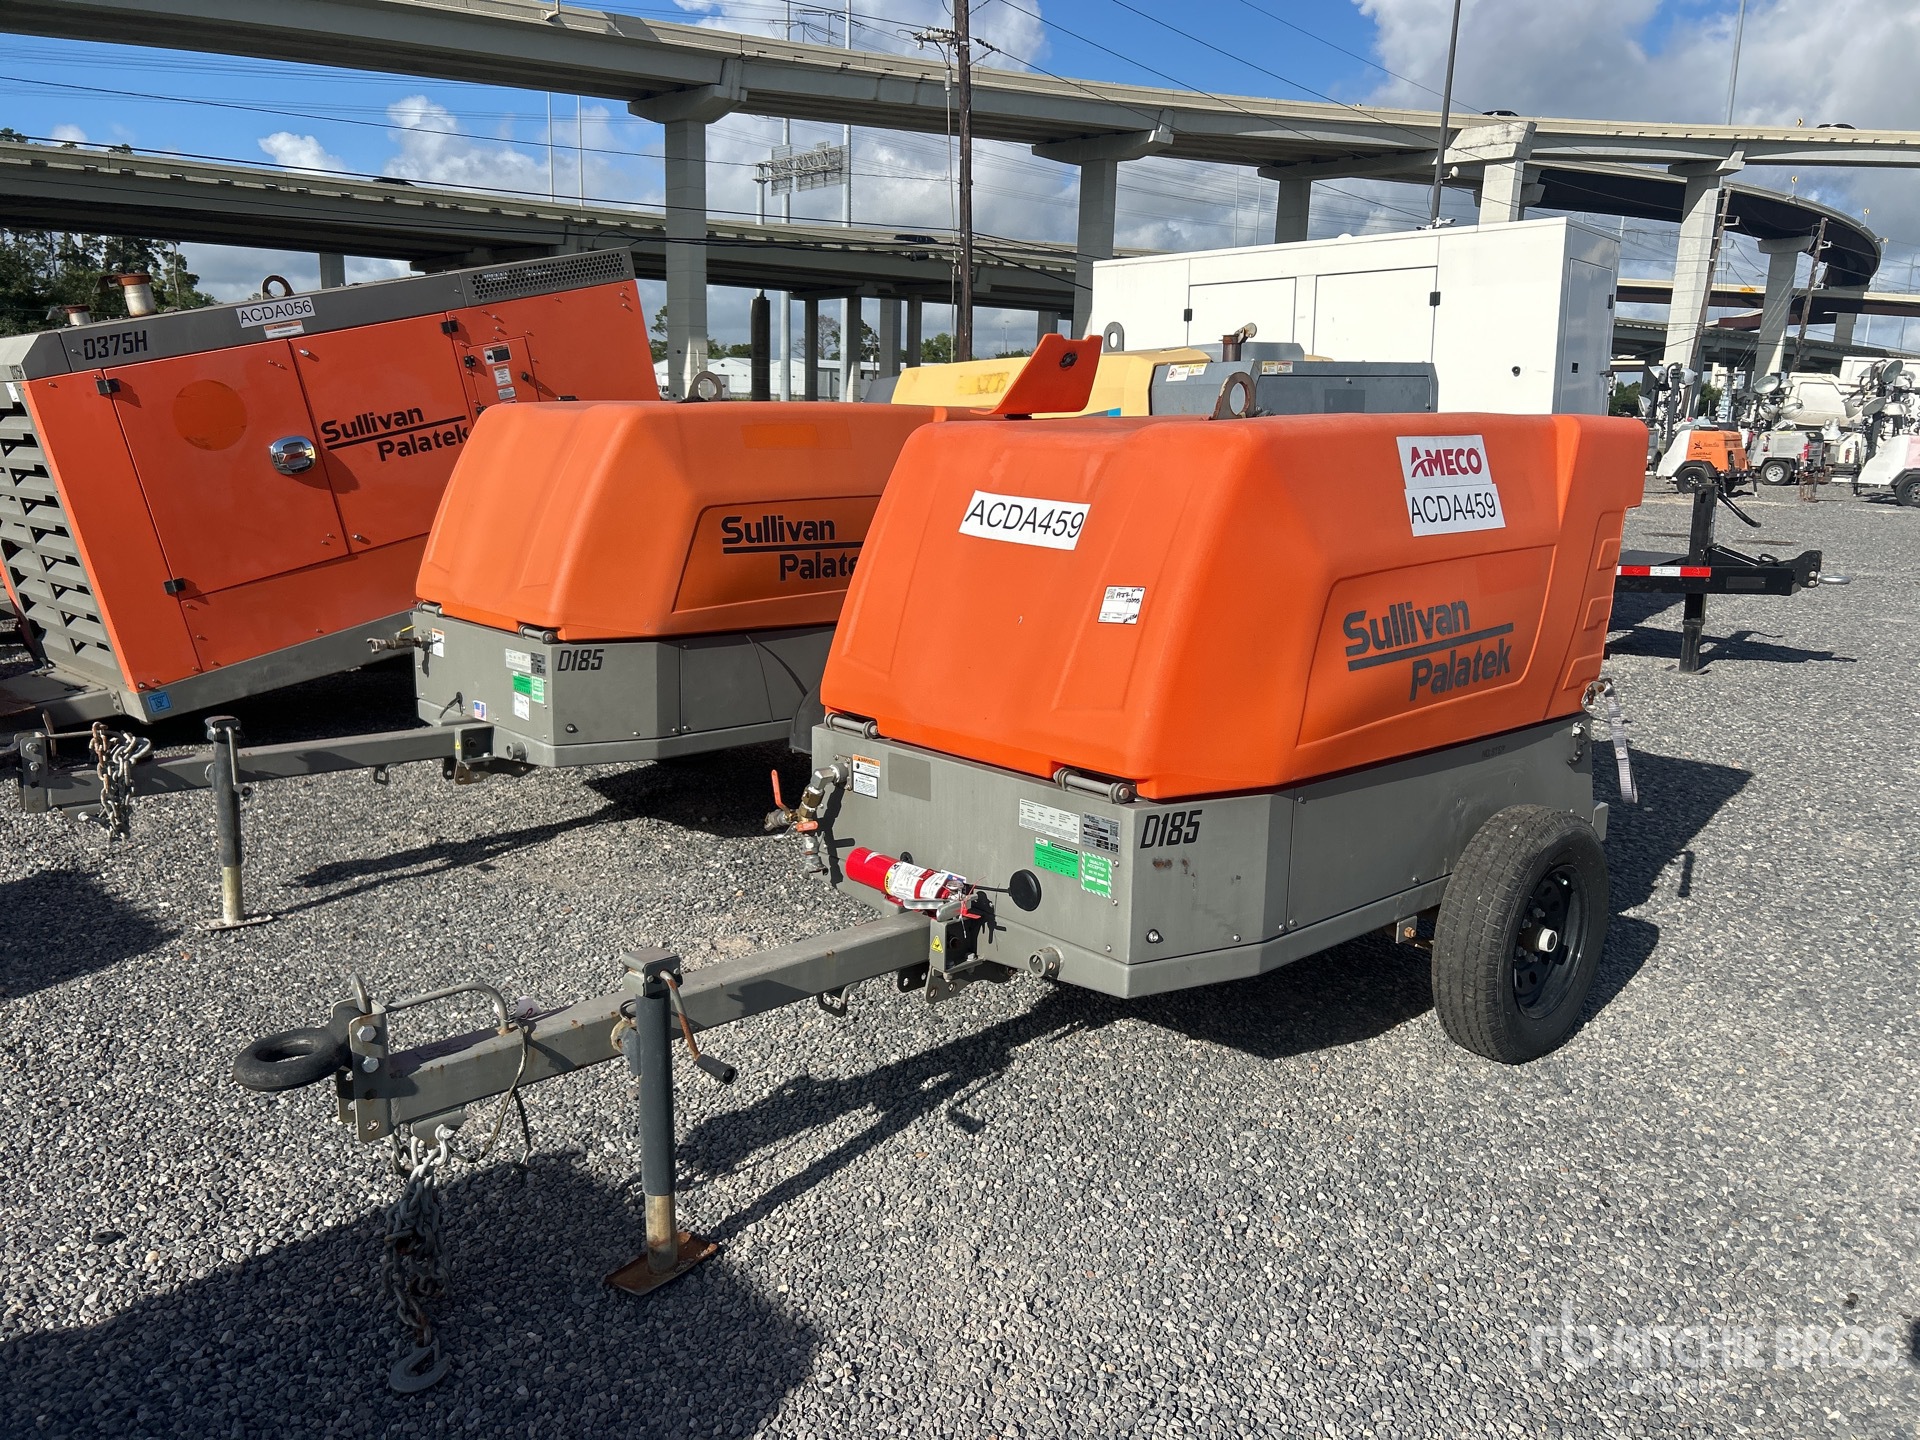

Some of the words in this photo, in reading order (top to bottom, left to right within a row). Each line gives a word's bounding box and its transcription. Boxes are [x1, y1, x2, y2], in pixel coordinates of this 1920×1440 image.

[240, 300, 312, 324] ACDA056
[83, 330, 148, 361] D375H
[320, 407, 425, 444] Sullivan
[376, 424, 470, 462] Palatek
[1411, 446, 1482, 478] AMECO
[964, 499, 1085, 539] ACDA459
[1411, 492, 1496, 525] ACDA459
[721, 515, 836, 545] Sullivan
[779, 551, 859, 582] Palate
[1343, 600, 1471, 657] Sullivan
[557, 648, 605, 672] D185
[1409, 638, 1512, 702] Palatek
[1140, 809, 1203, 849] D185
